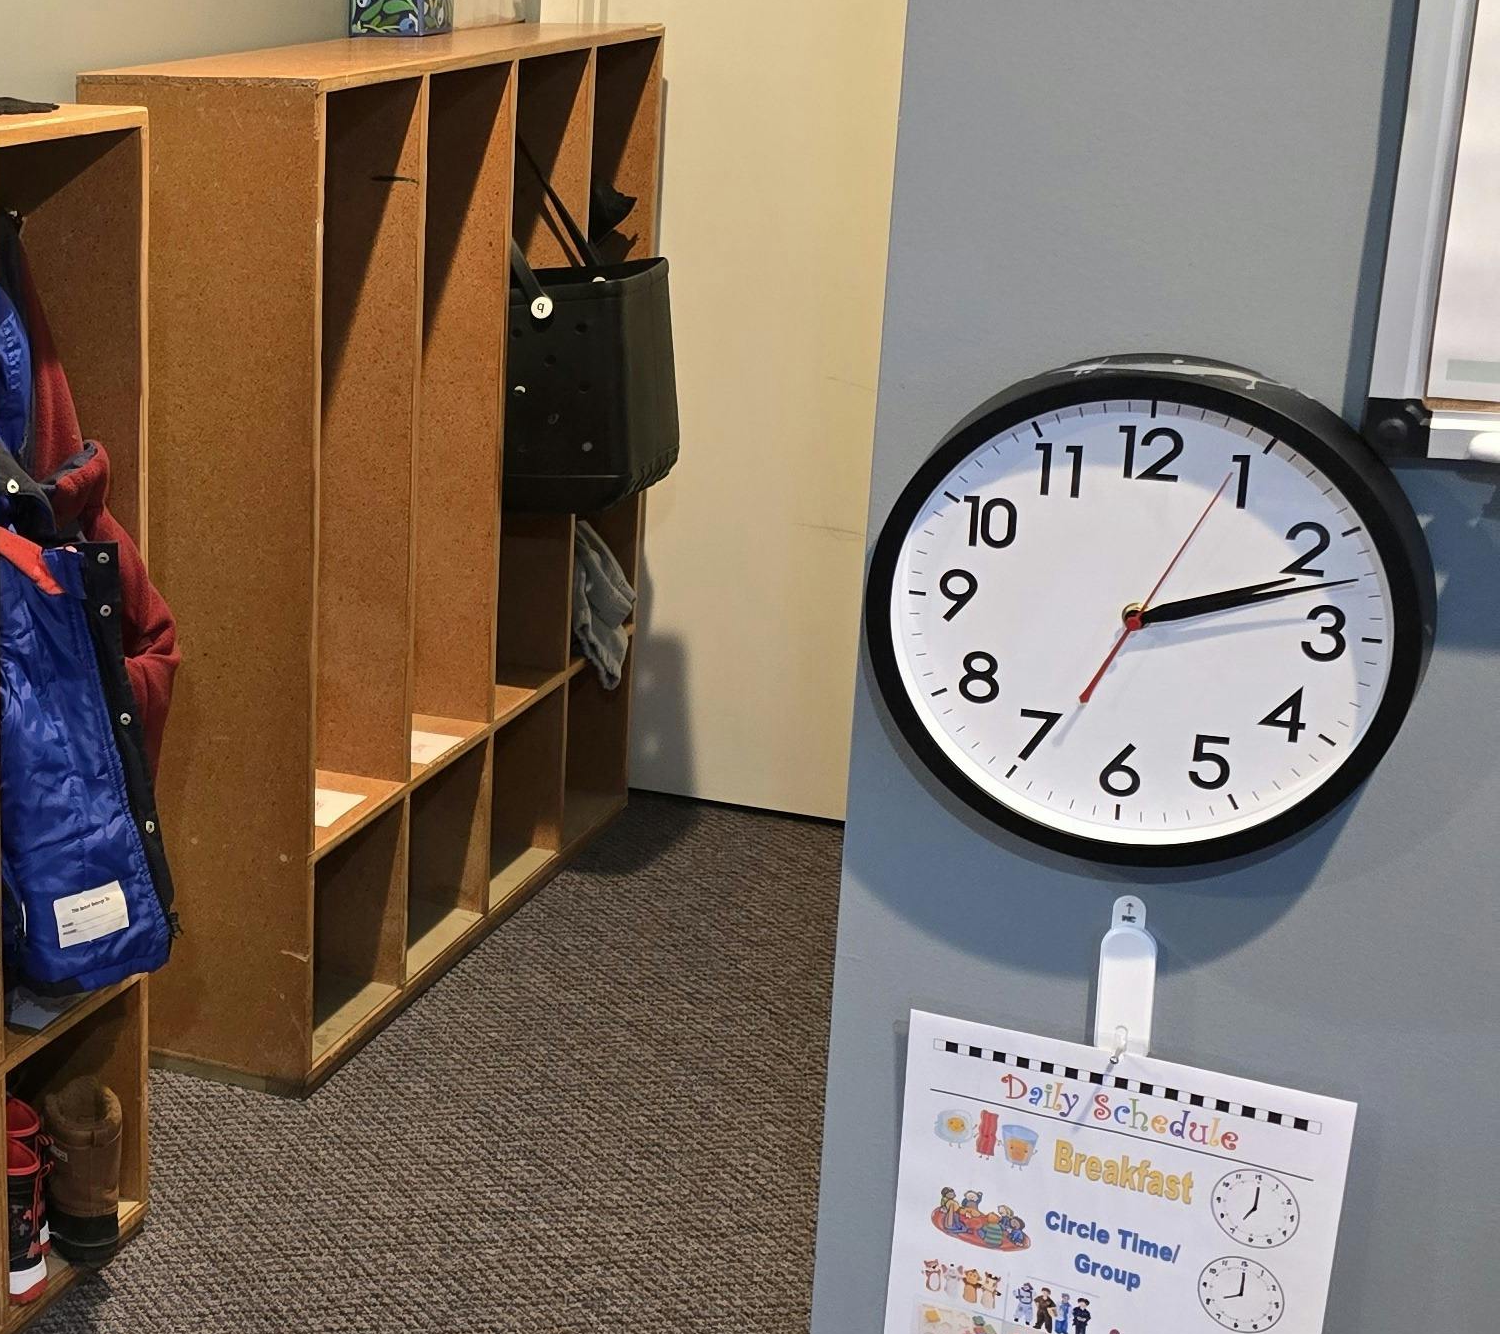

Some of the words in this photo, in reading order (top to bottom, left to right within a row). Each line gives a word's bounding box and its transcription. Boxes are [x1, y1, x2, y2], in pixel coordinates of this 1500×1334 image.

[1034, 441, 1084, 499] 11
[1118, 424, 1185, 483] 12
[1230, 453, 1252, 510] 1
[963, 495, 1018, 549] 10
[1279, 521, 1332, 578] 2
[938, 568, 979, 622] 9
[1299, 603, 1347, 663] 3
[958, 650, 1000, 704] 8
[1018, 708, 1063, 761] 7
[1257, 685, 1306, 744] 4
[1098, 741, 1141, 798] 6
[1188, 734, 1230, 790] 5
[1001, 1073, 1080, 1118] Daily
[1093, 1093, 1240, 1151] Schedule
[1053, 1138, 1194, 1205] Breakfast
[1044, 1210, 1110, 1245] Circle
[1117, 1228, 1182, 1265] Time/
[1074, 1253, 1141, 1292] Group
